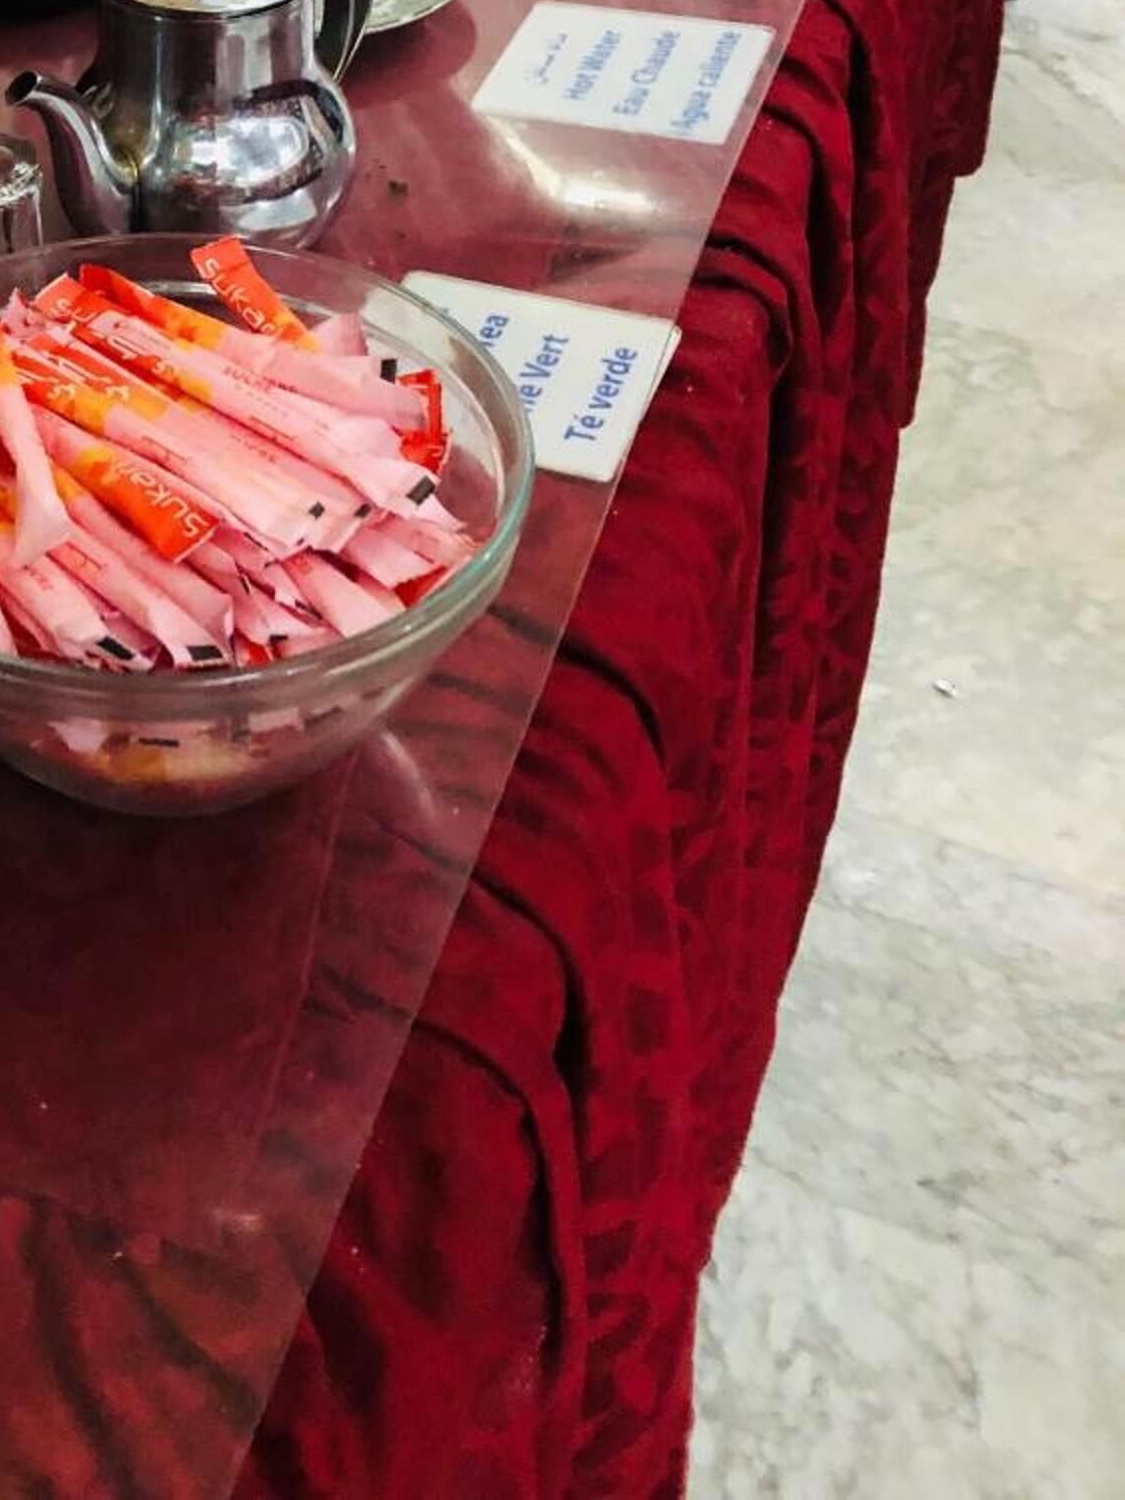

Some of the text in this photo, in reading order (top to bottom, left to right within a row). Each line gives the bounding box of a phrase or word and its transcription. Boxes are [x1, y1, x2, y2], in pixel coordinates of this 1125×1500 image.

[561, 29, 622, 101] Hot Water
[611, 28, 682, 116] Eau Chaude
[699, 30, 742, 88] caliente
[520, 334, 571, 379] Vert
[563, 347, 639, 443] Té verde
